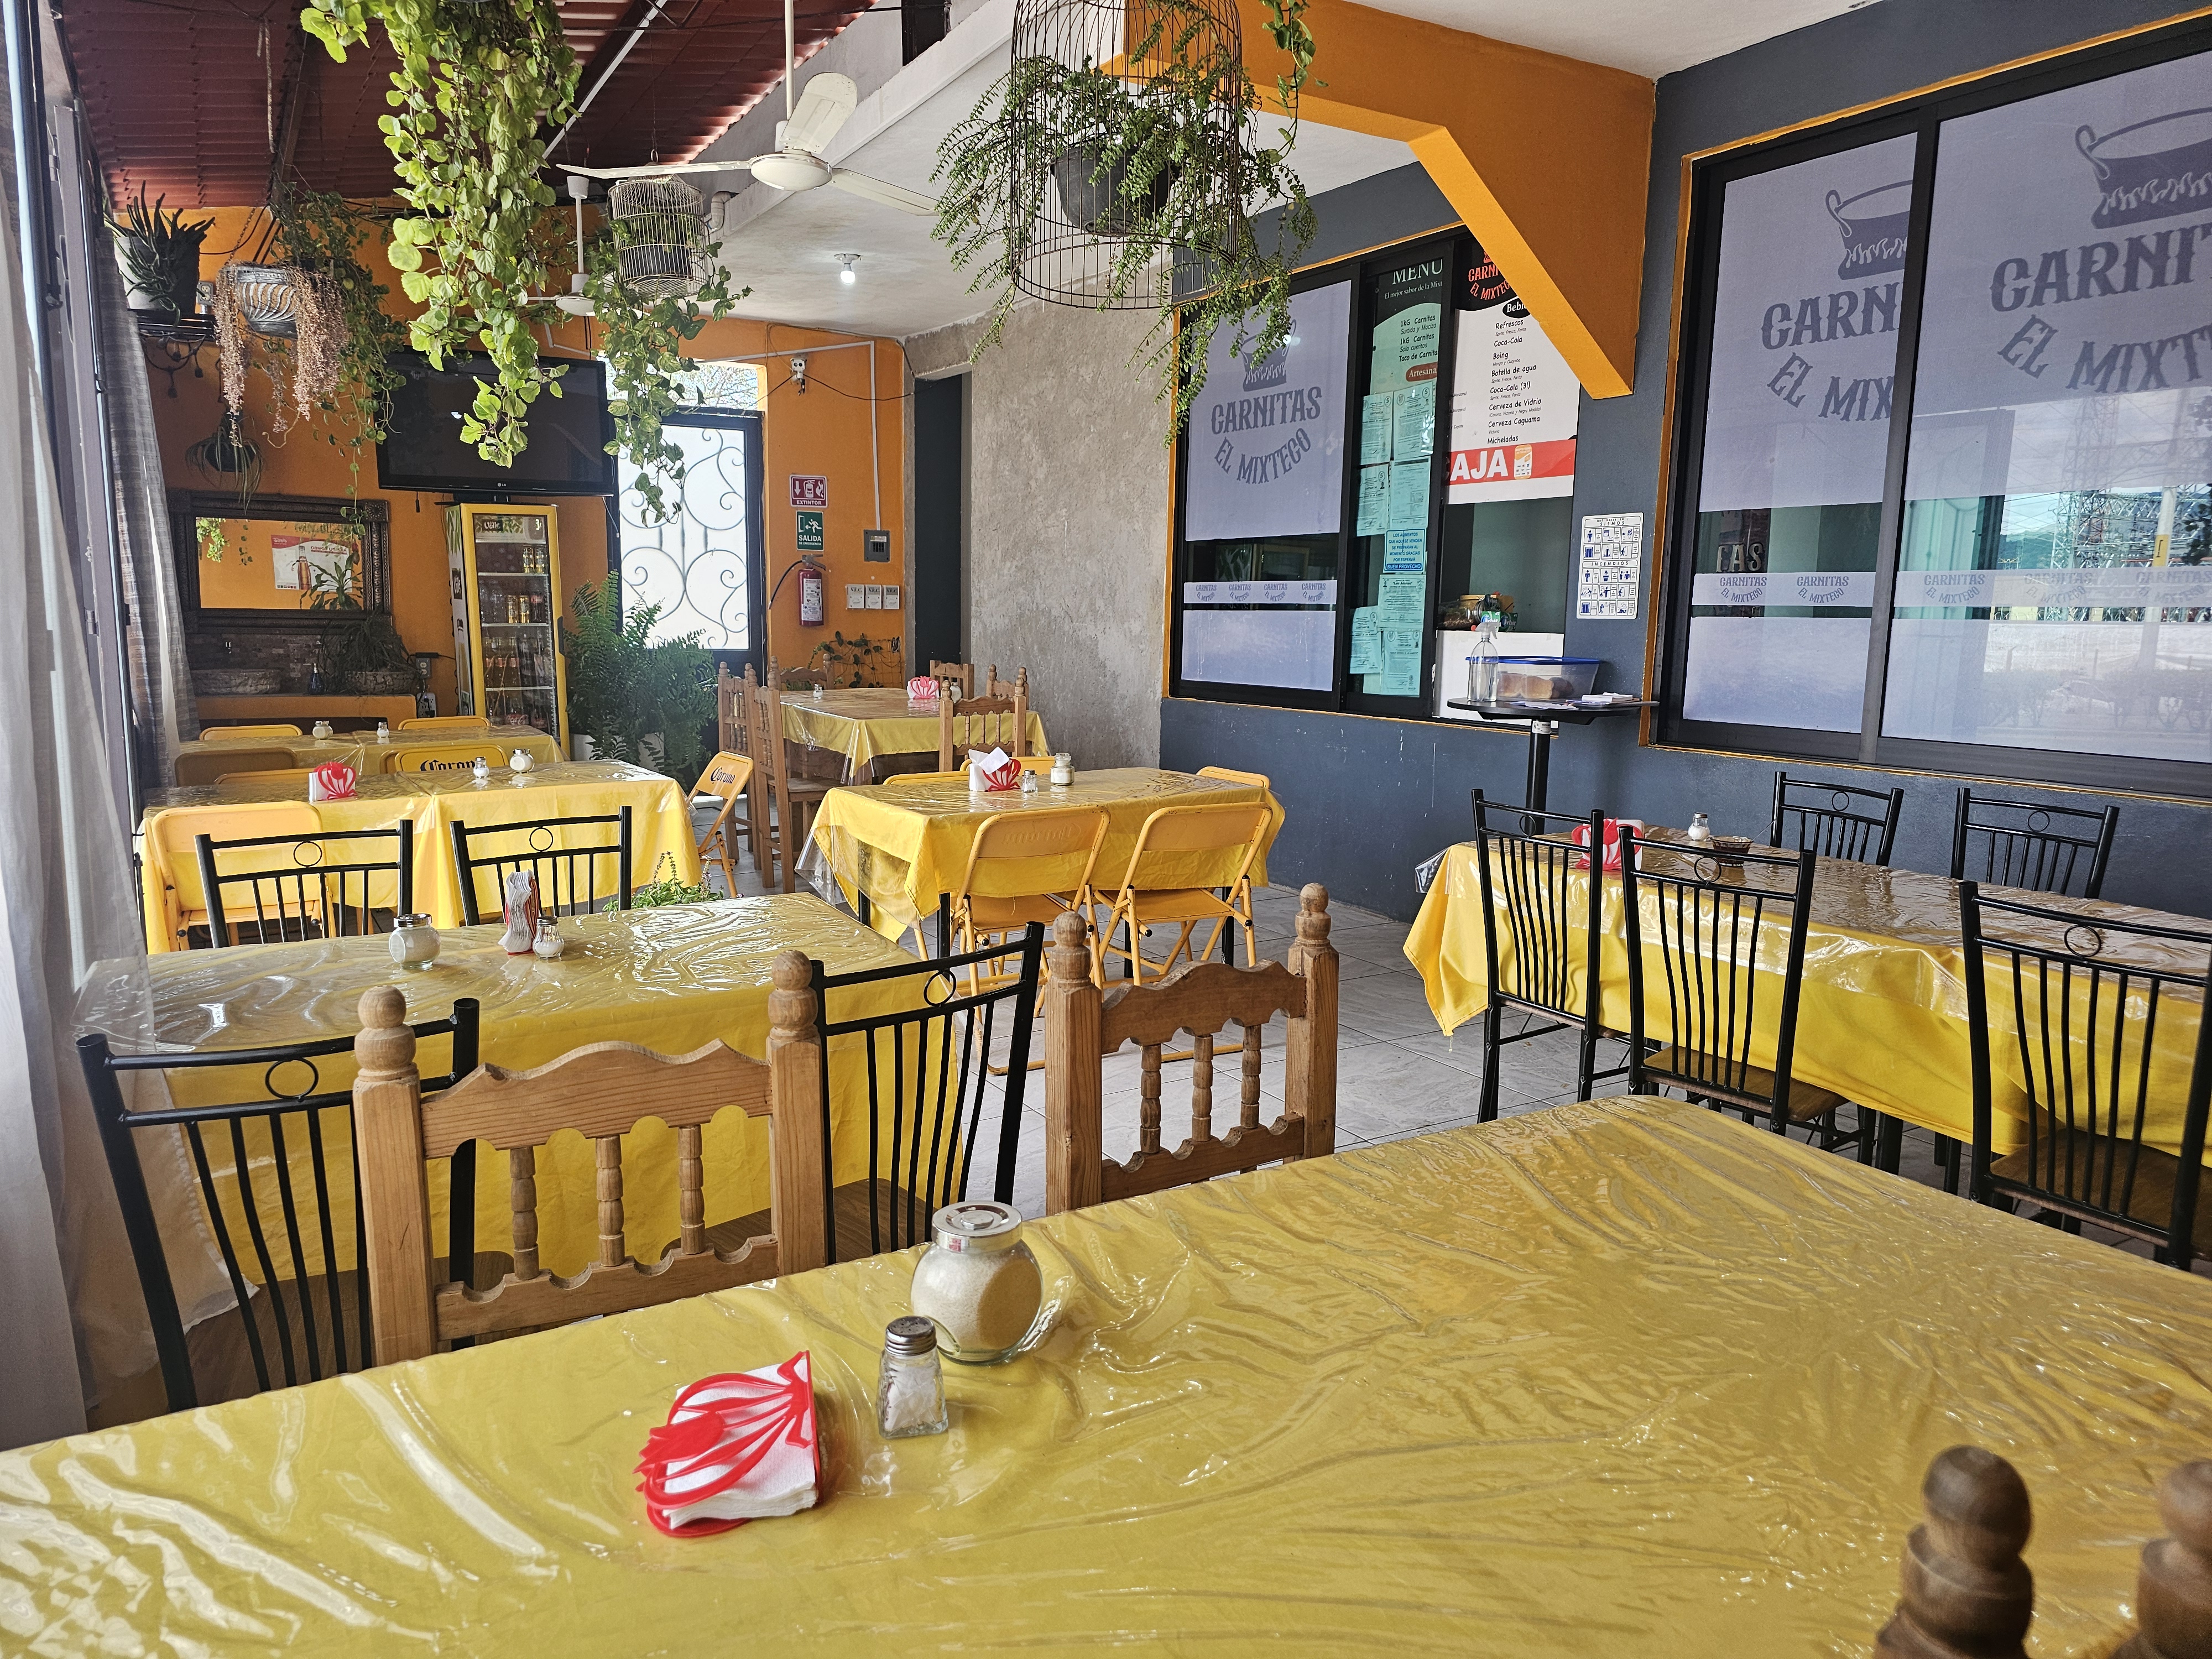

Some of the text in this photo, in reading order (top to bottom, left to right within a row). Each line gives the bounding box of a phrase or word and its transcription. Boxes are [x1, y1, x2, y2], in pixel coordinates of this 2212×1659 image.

[1392, 259, 1443, 285] MENU
[1989, 221, 2212, 312] CARNI
[1470, 282, 1479, 297] EL
[1414, 315, 1436, 324] Carnitas
[1761, 282, 1900, 349] CARN
[1495, 320, 1524, 330] Refrescos
[1413, 333, 1434, 342] Carnitas
[1494, 336, 1522, 347] Coca-Cola
[1419, 349, 1438, 358] Carnita
[1493, 352, 1509, 360] Boing
[1997, 314, 2212, 393] EL MIXT
[1491, 368, 1511, 377] Botella
[1522, 365, 1536, 374] agua
[1490, 384, 1518, 394] Coca-Cola
[1766, 352, 1894, 421] EL MIX
[1524, 398, 1541, 406] Vidrio
[1211, 386, 1322, 435] CARNITAS
[1514, 416, 1540, 426] Caguama
[1487, 435, 1519, 444] Micheladas
[1214, 436, 1234, 474] EL
[1237, 428, 1311, 484] MIXTECO
[1720, 577, 1767, 587] CARNITAS
[1797, 576, 1849, 587] CARNITAS
[1924, 573, 1986, 585] CARNITAS
[1302, 591, 1307, 599] EL
[1720, 587, 1763, 603] EL MIXTECO
[1798, 587, 1844, 603] EL MIXTECO
[1926, 586, 1980, 604] EL MIXTECO
[420, 759, 476, 771] Coron
[711, 766, 735, 784] Corona
